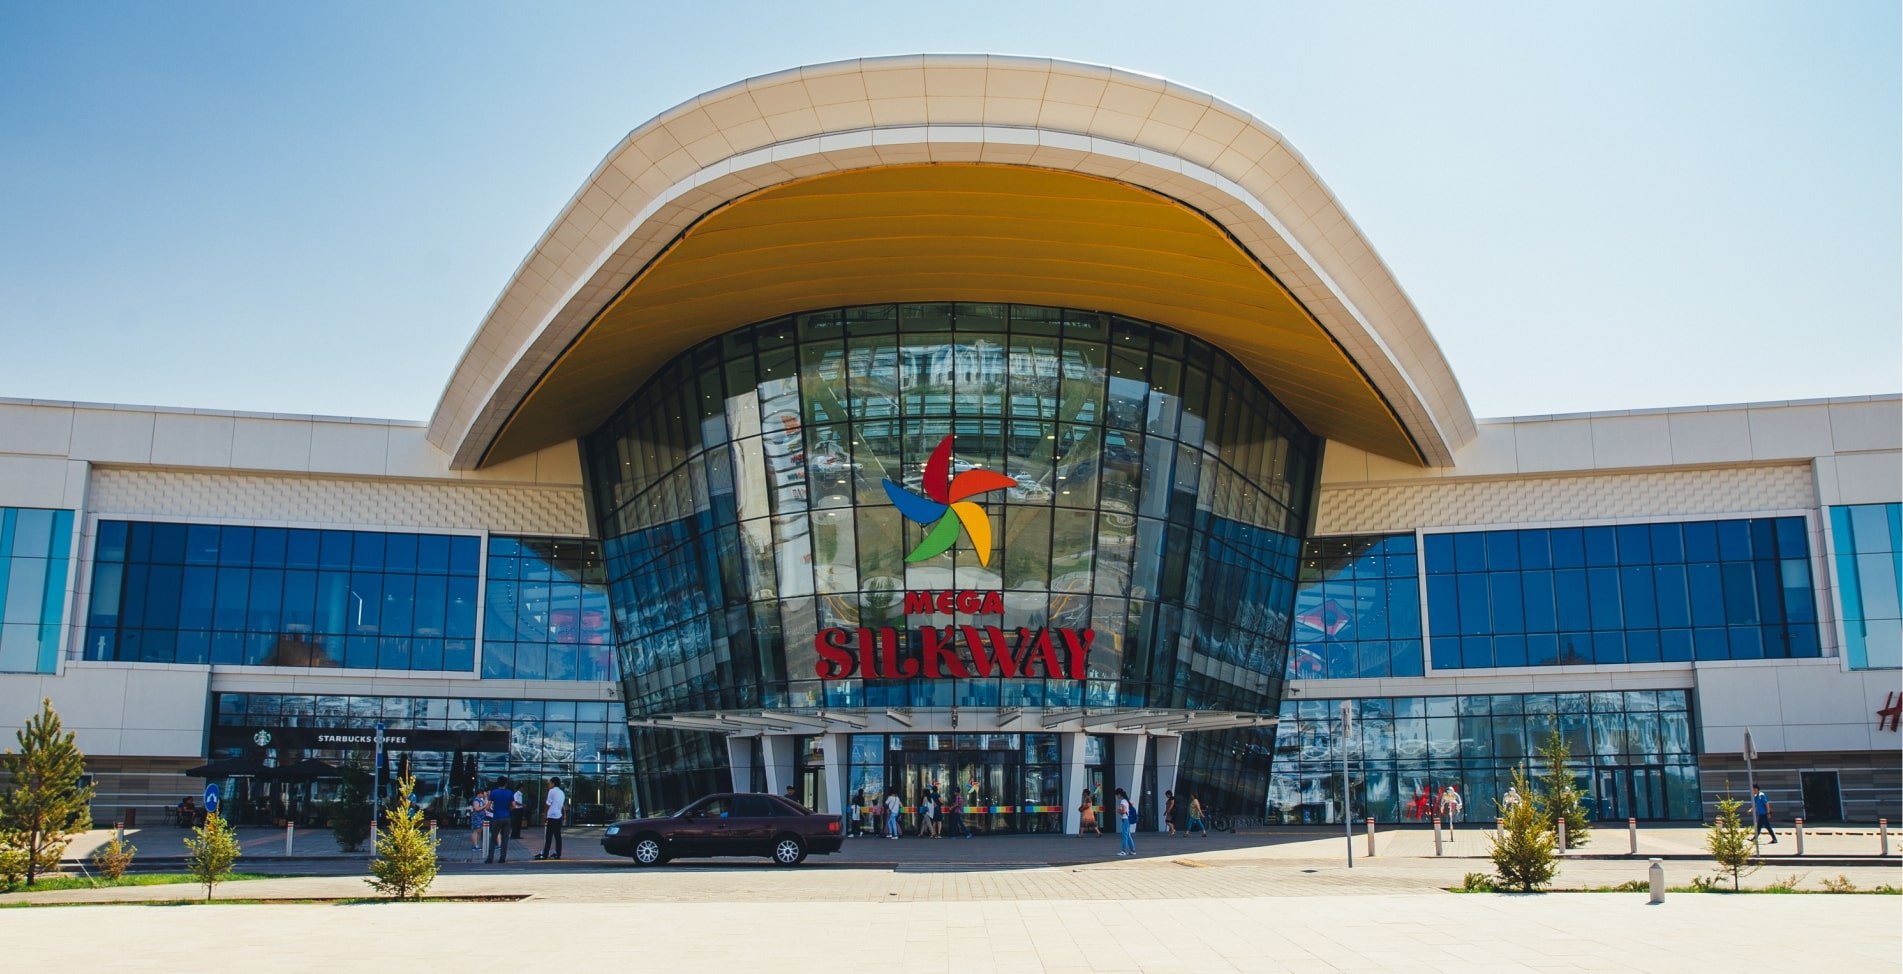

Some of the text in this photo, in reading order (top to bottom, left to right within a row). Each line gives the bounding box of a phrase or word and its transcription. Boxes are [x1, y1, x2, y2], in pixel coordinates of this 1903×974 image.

[904, 590, 1005, 615] MEGA
[815, 625, 1095, 680] SILKWAY
[318, 735, 371, 743] STARBUCKS
